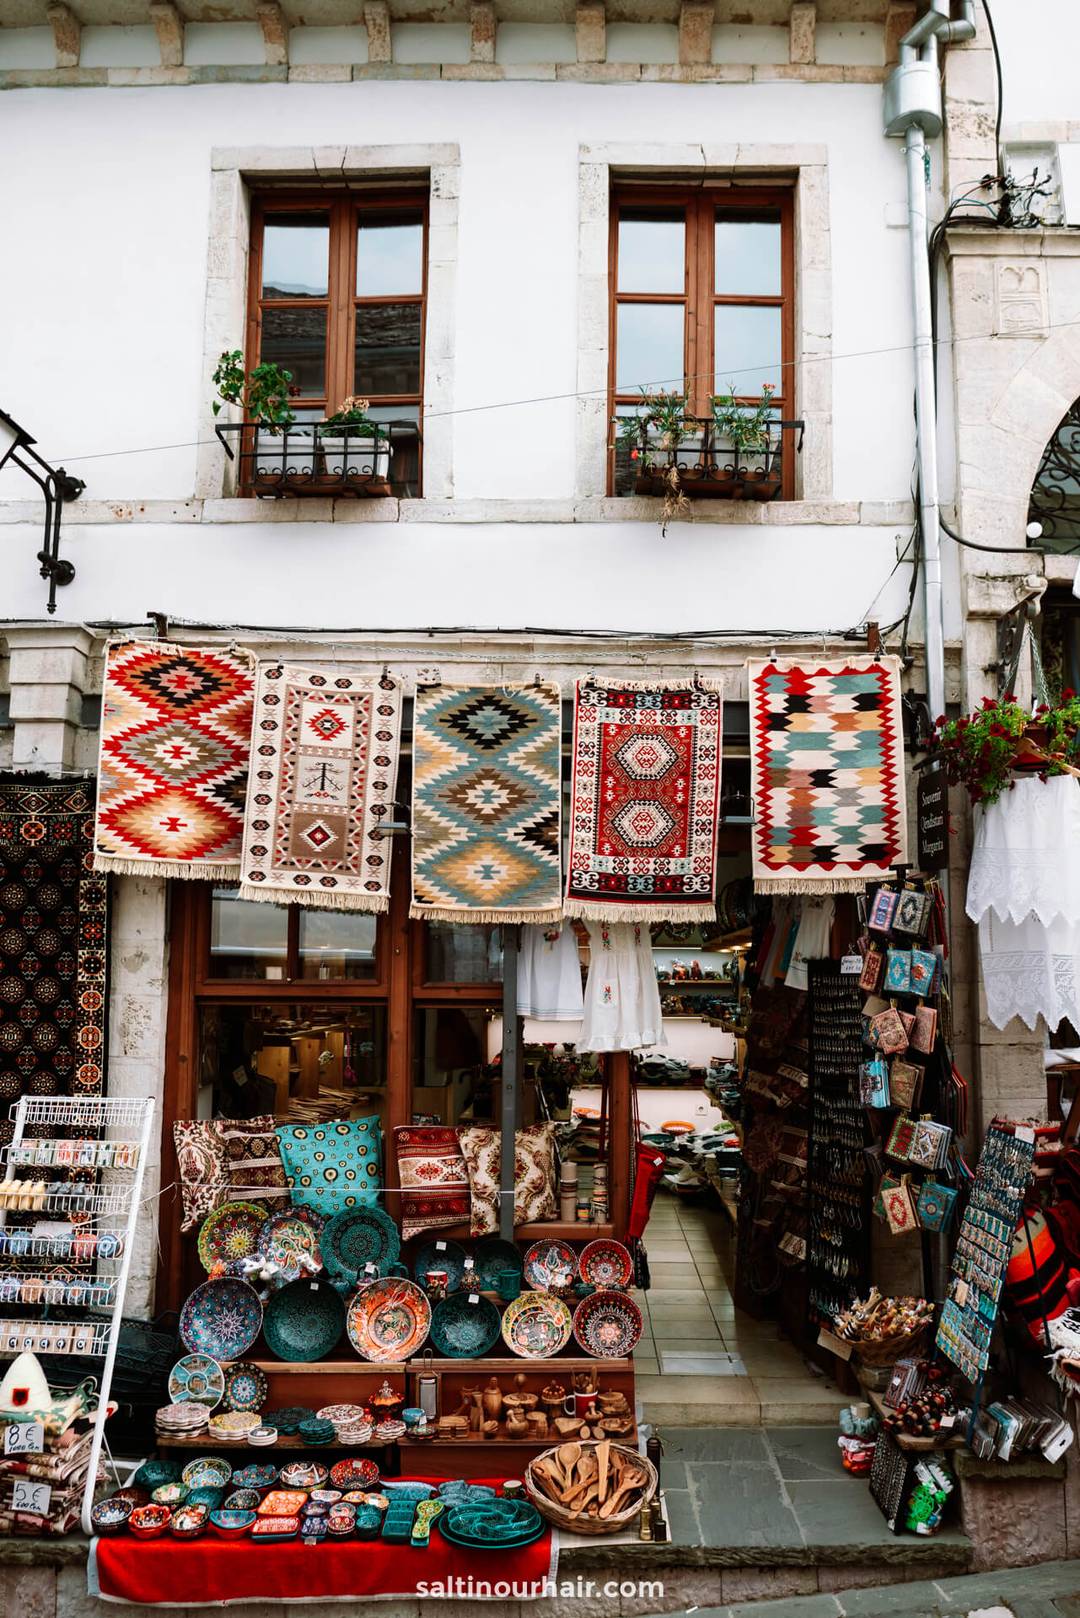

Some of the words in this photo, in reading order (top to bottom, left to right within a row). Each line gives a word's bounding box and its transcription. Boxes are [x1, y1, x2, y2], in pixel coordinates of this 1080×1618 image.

[922, 787, 942, 807] Souvenir
[8, 1424, 20, 1446] 8
[25, 1425, 37, 1442] €
[15, 1483, 27, 1502] 5
[32, 1486, 45, 1503] €
